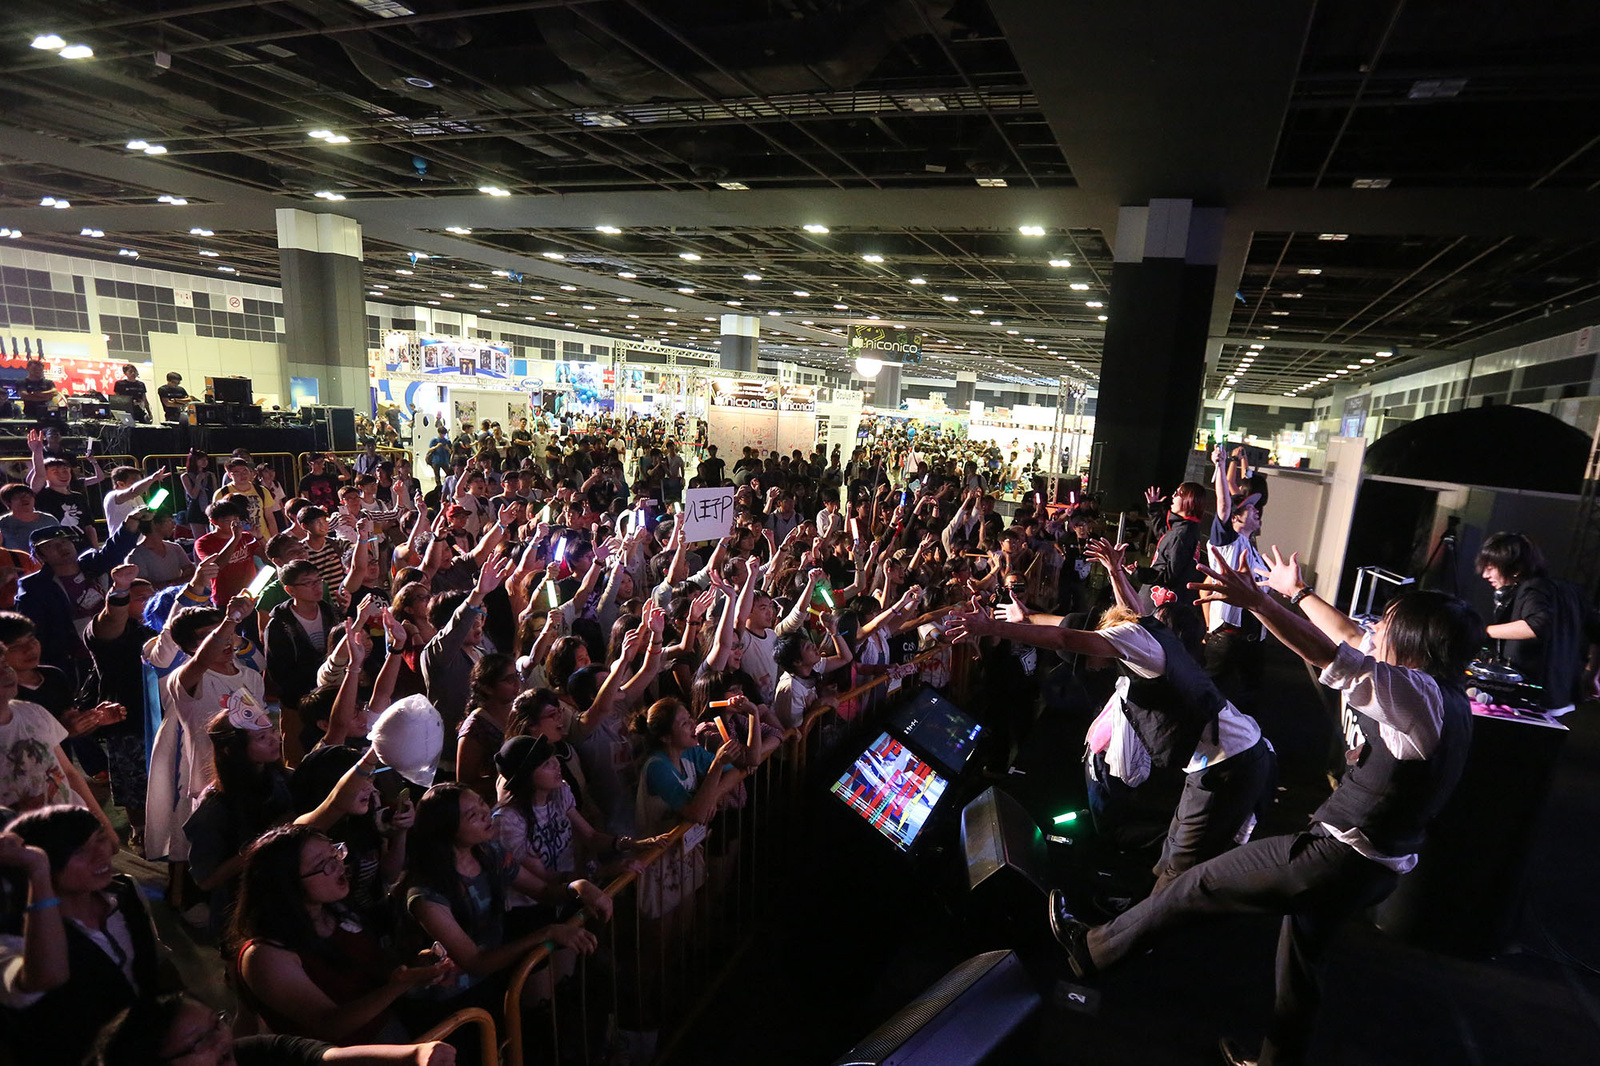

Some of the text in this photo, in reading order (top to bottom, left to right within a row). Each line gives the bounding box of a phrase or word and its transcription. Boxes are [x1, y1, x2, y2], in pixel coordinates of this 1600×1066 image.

[866, 339, 918, 354] niconico
[725, 396, 775, 409] niconico
[685, 495, 733, 523] 八王子P
[1067, 992, 1087, 1004] 2
